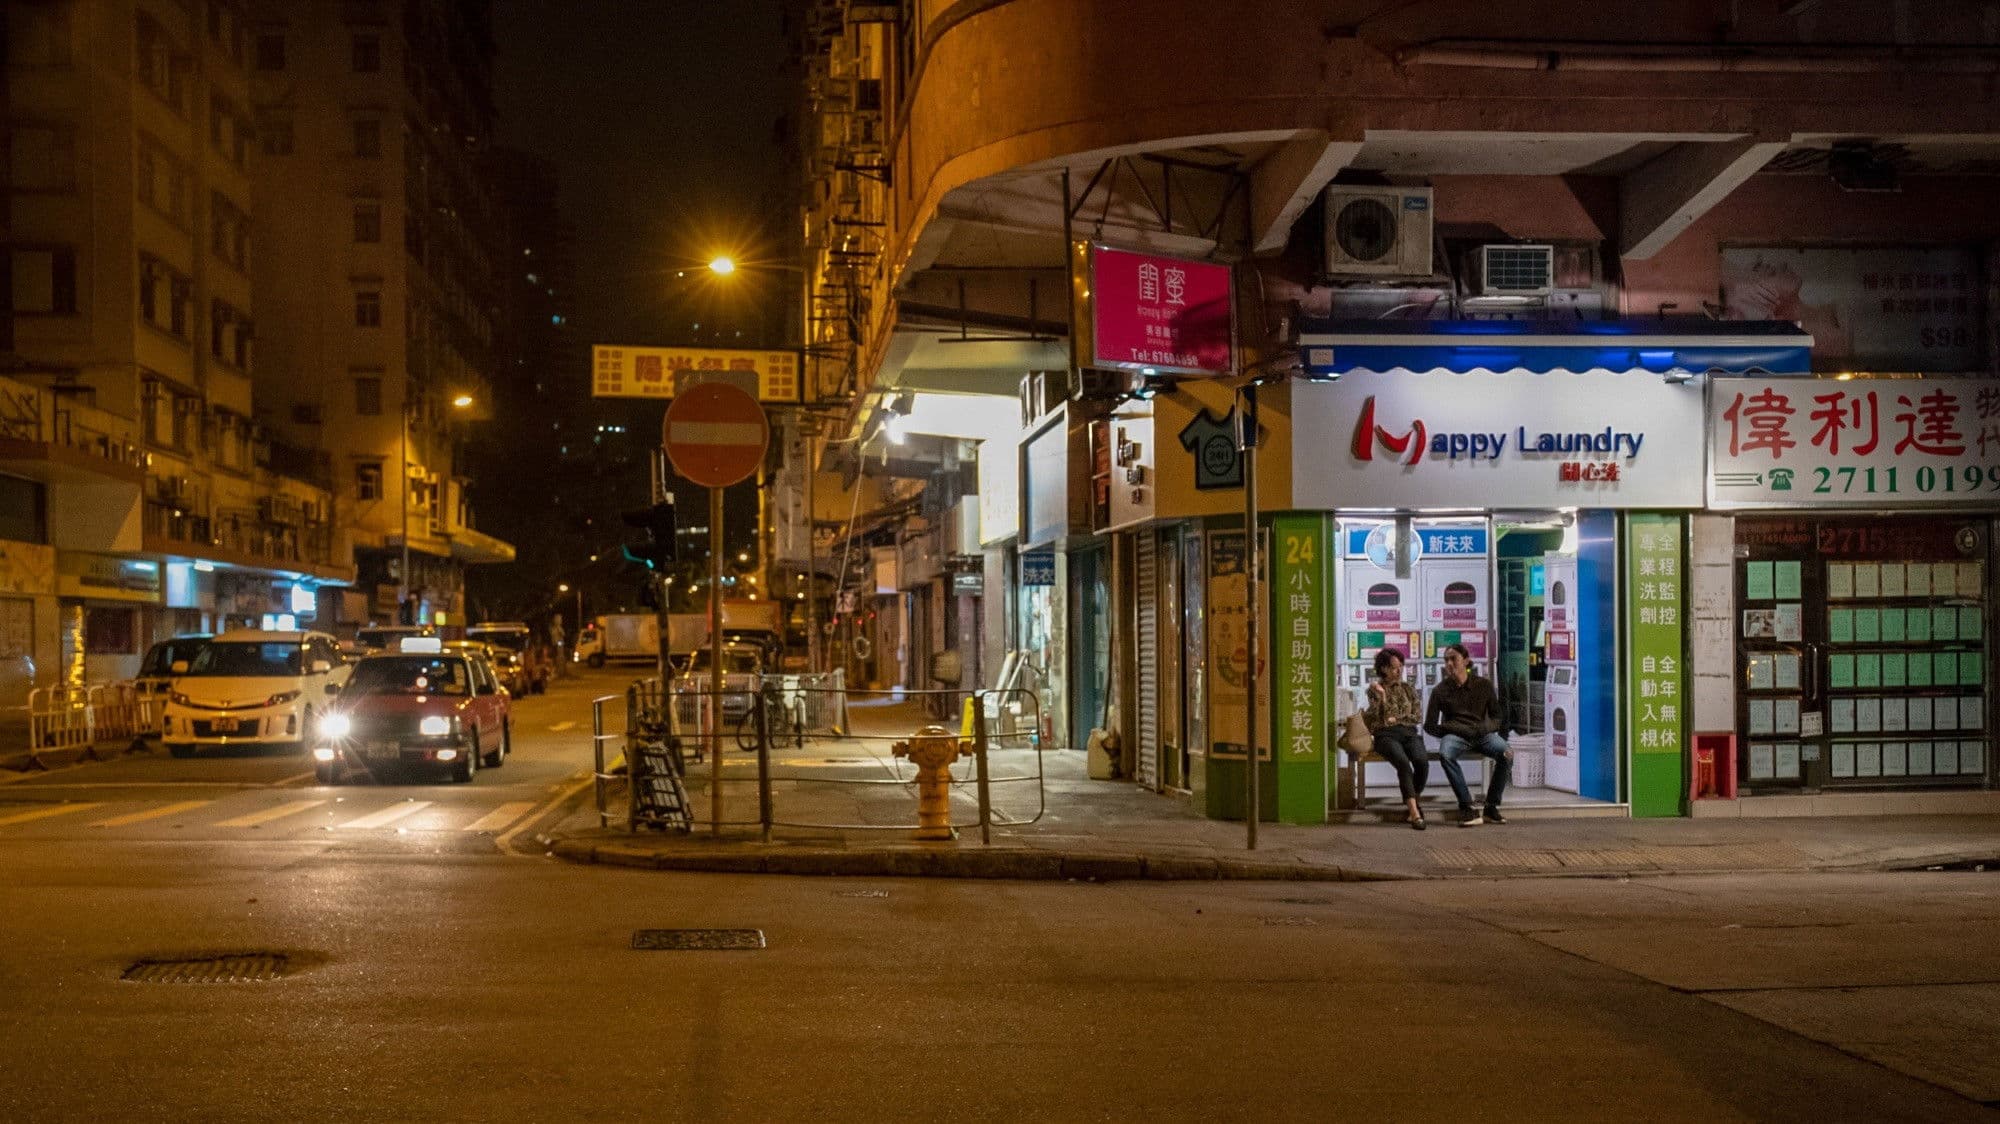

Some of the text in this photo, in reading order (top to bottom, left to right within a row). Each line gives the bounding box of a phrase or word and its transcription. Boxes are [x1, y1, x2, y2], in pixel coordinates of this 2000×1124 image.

[1138, 262, 1185, 305] 閨蜜
[1130, 347, 1151, 362] Tel:
[1722, 387, 1966, 459] 偉利達
[1518, 425, 1645, 459] Laundry
[1812, 466, 1901, 494] 2711
[1429, 535, 1475, 553] 新未來
[1023, 567, 1054, 583] 洗衣
[1658, 655, 1678, 748] 全年無休
